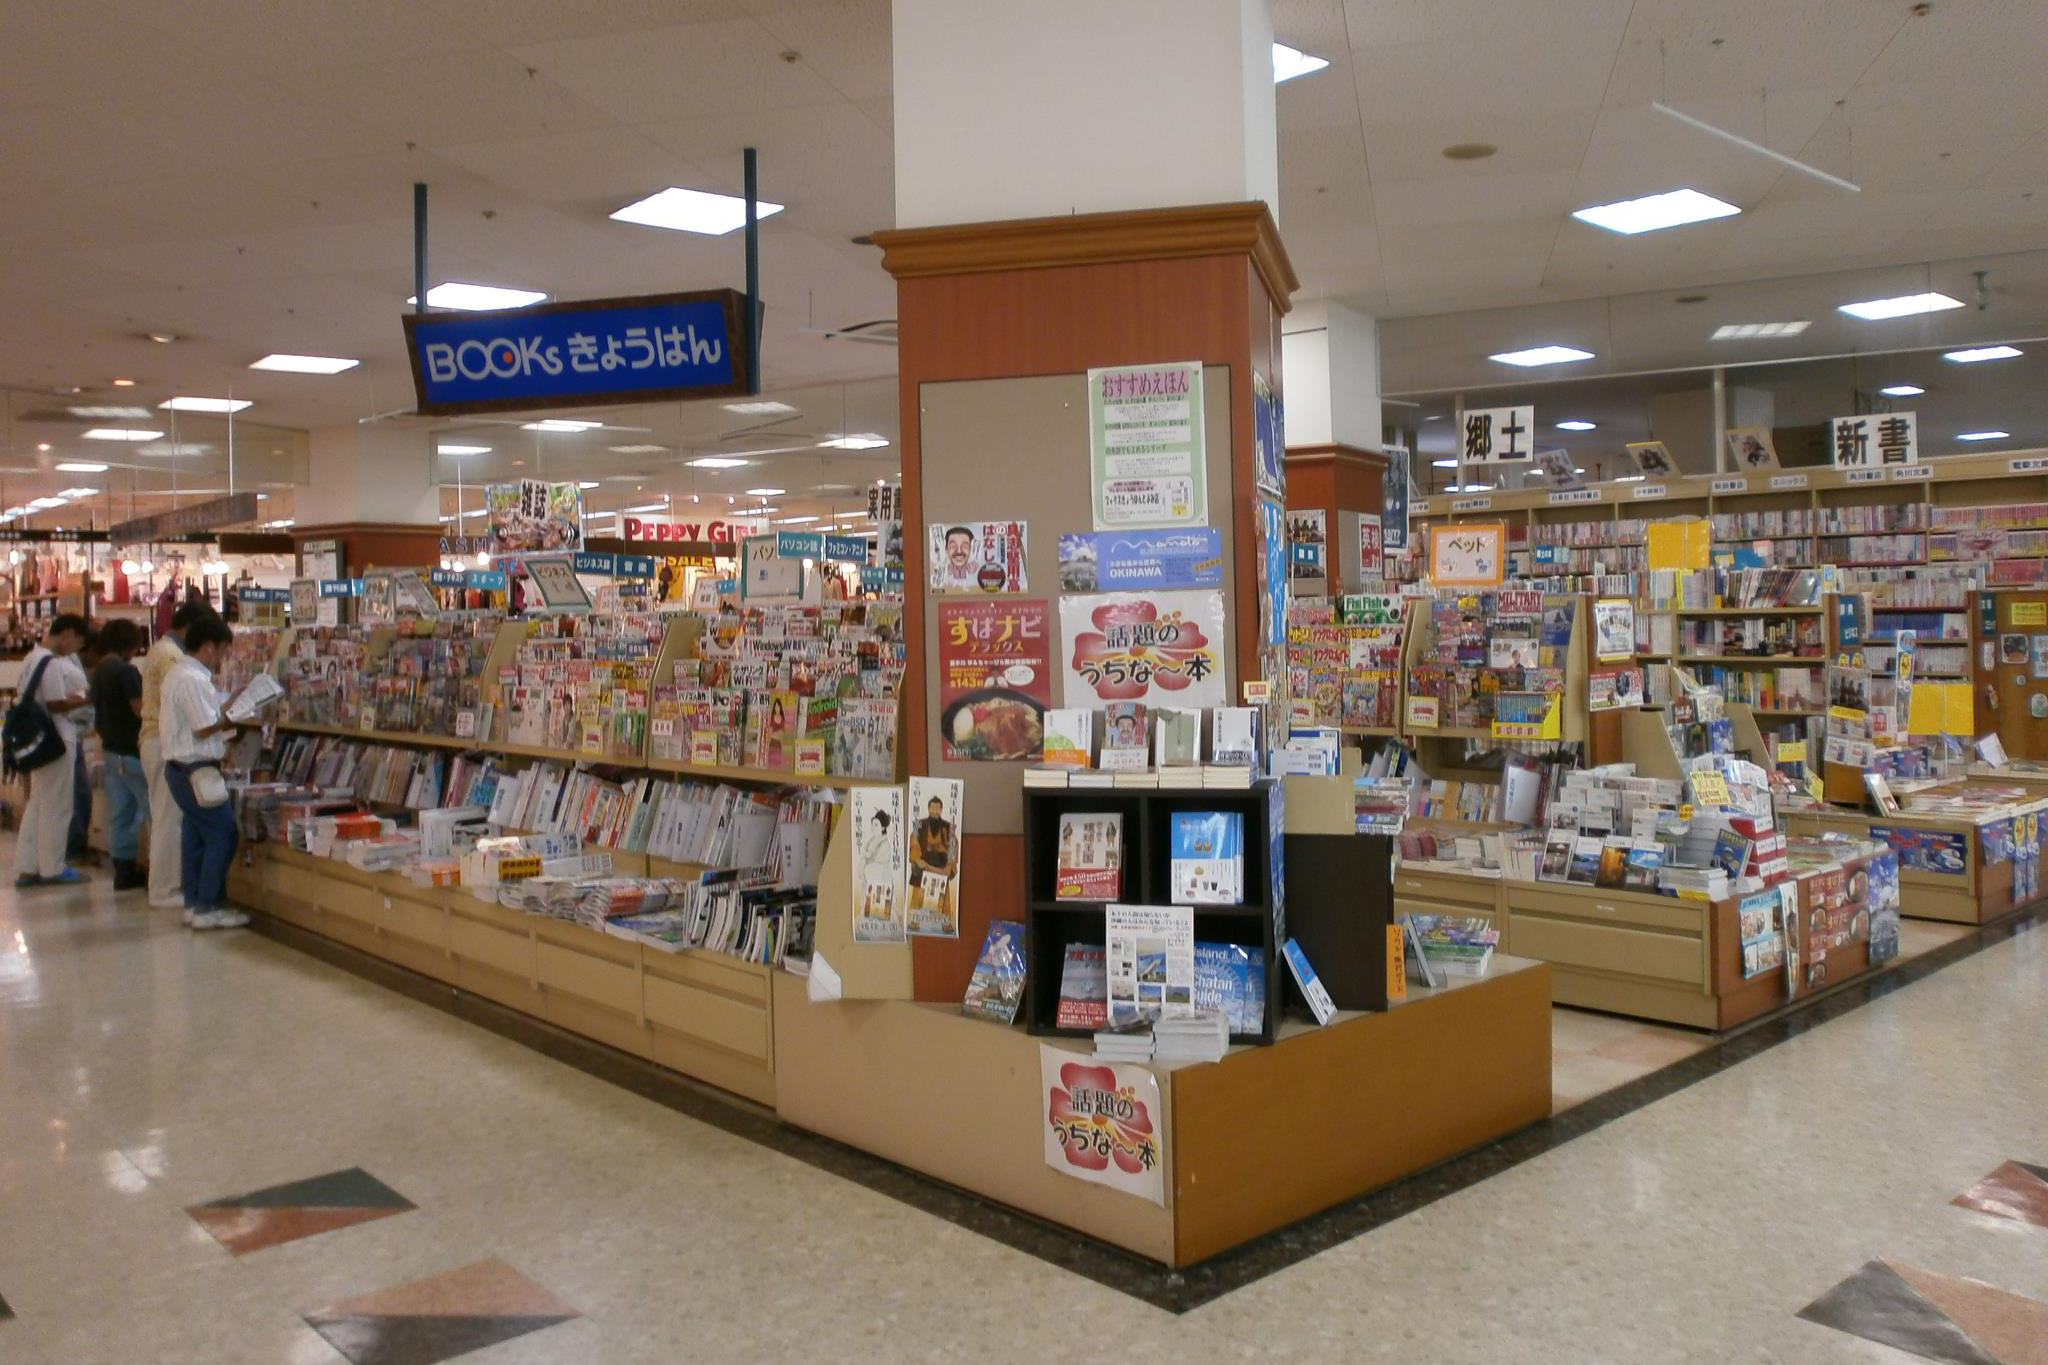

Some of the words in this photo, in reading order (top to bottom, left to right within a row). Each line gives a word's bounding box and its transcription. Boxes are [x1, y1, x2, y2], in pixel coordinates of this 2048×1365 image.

[566, 324, 722, 373] きょうはん
[1102, 369, 1190, 398] おすすめえほん
[1465, 410, 1526, 461] 郷土
[1837, 416, 1911, 465] 新書
[1896, 467, 1930, 478] 角川文庫
[624, 518, 701, 543] PEPPY
[982, 524, 996, 563] はなし
[1110, 566, 1162, 579] OKINAWA
[1498, 591, 1543, 603] MILITARY
[947, 614, 1042, 646] すばナビ
[1105, 616, 1180, 650] 話題の
[1071, 1087, 1134, 1120] 話題の
